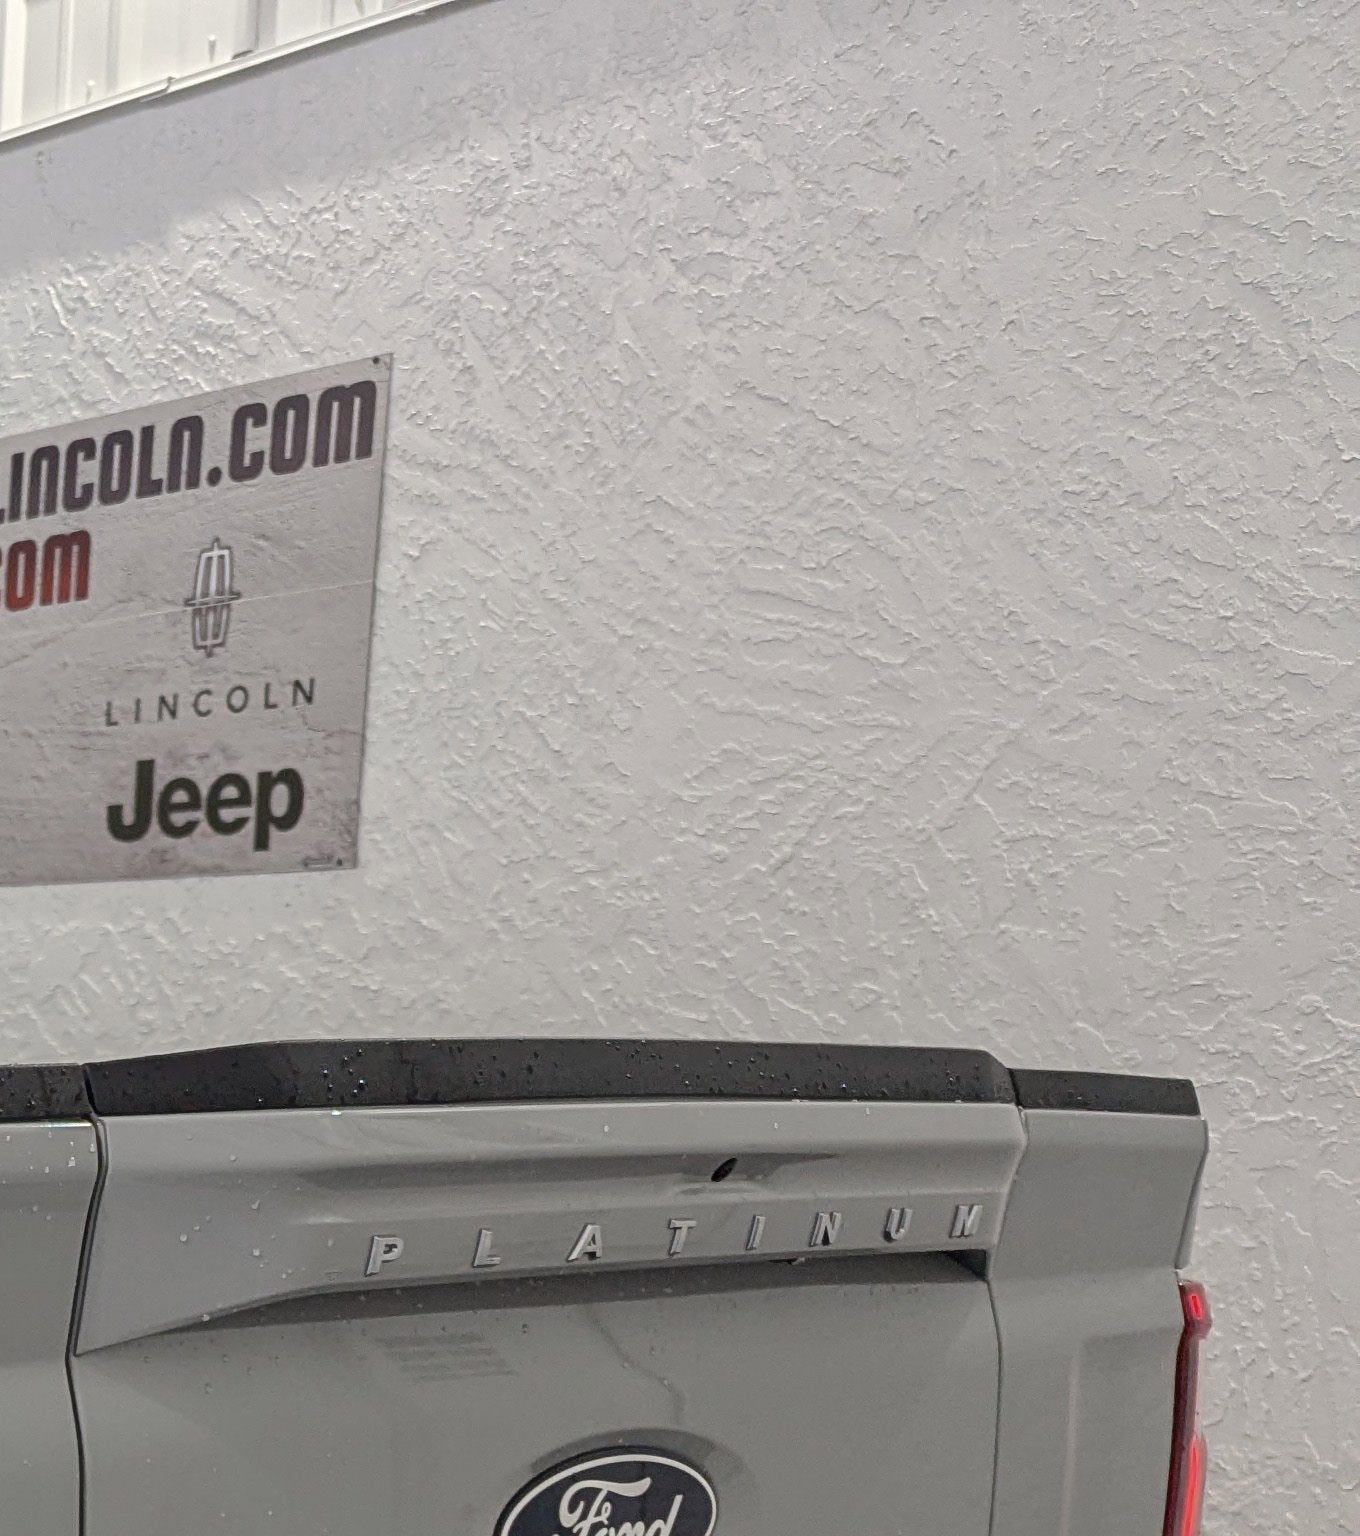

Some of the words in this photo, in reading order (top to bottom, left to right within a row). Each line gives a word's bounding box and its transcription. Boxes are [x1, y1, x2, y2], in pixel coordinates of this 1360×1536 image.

[104, 677, 316, 728] LINCOLN
[106, 758, 305, 852] Jeep
[363, 1202, 984, 1279] PLATINUM
